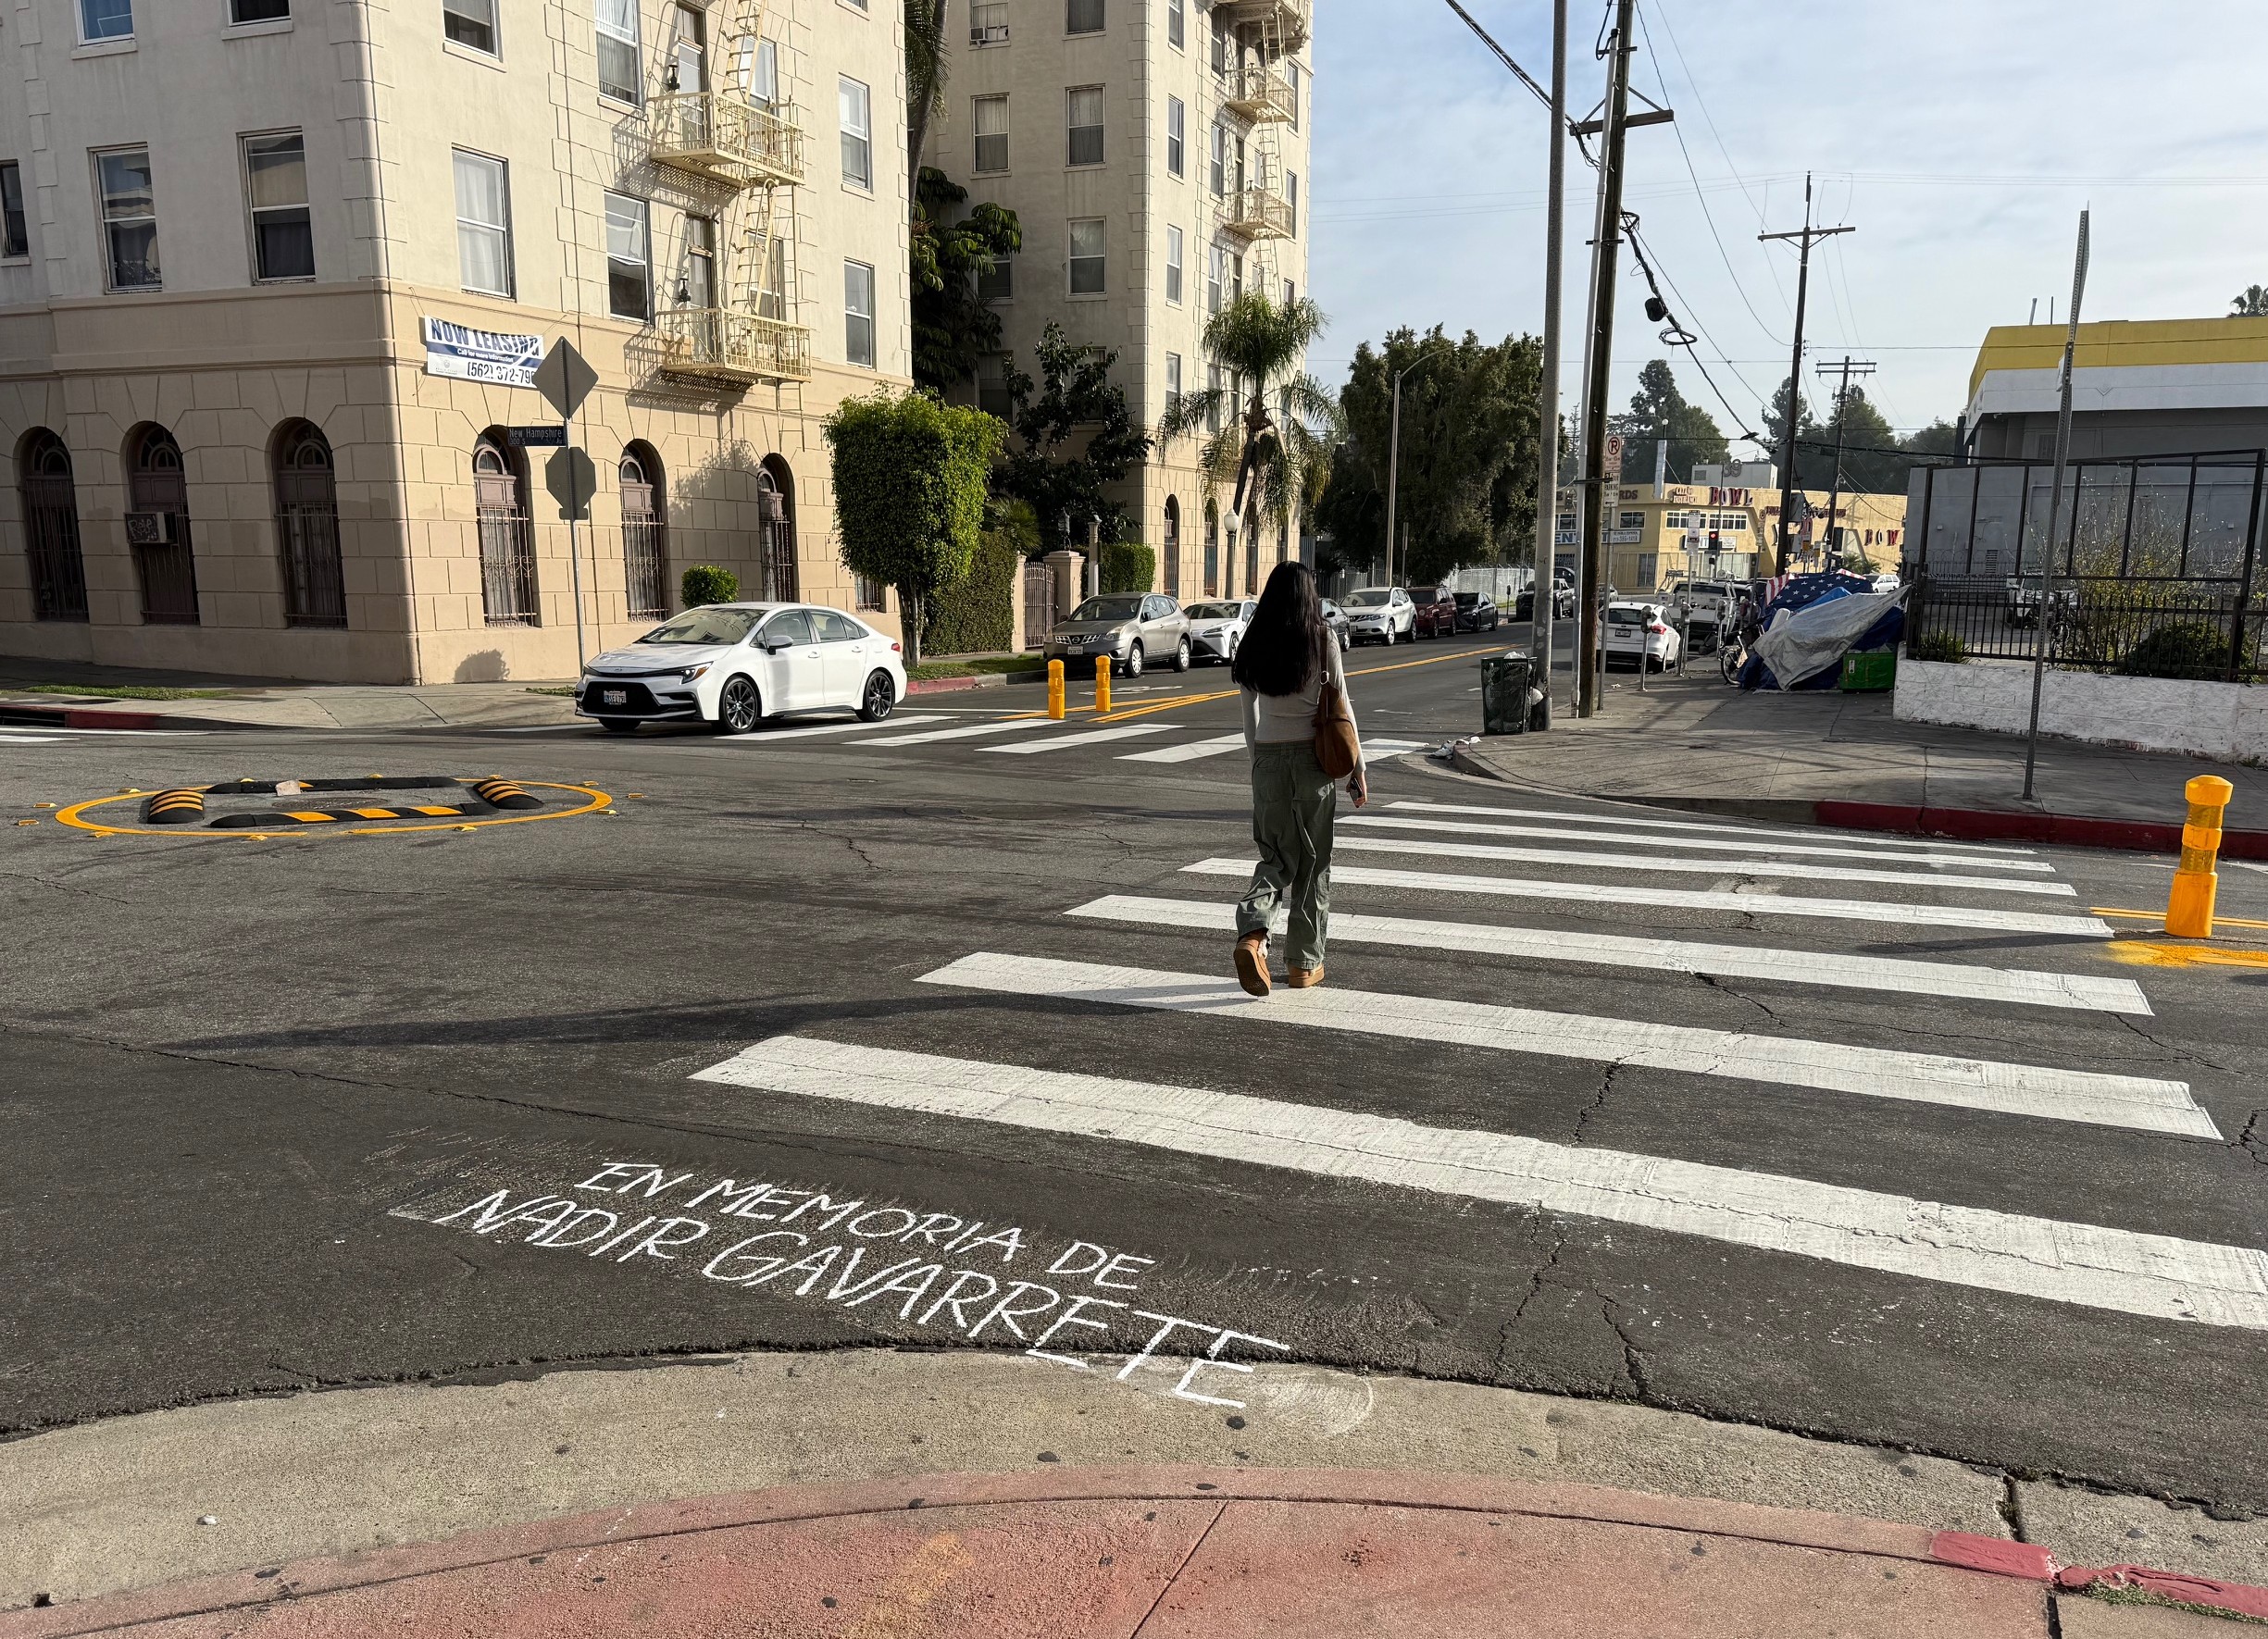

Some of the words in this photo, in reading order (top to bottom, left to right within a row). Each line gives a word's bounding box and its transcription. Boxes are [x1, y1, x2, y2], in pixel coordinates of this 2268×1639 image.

[430, 318, 469, 345] NOW
[473, 329, 540, 356] LEASING
[467, 361, 494, 379] (562)
[509, 427, 523, 438] New
[526, 427, 562, 441] Hampshire
[1709, 486, 1753, 506] BOWL
[573, 1162, 695, 1198] EN
[682, 1178, 1026, 1262] MEMORIA
[1044, 1241, 1156, 1289] DE
[432, 1188, 710, 1263] NADIR
[701, 1231, 1290, 1409] GAVARRETE
